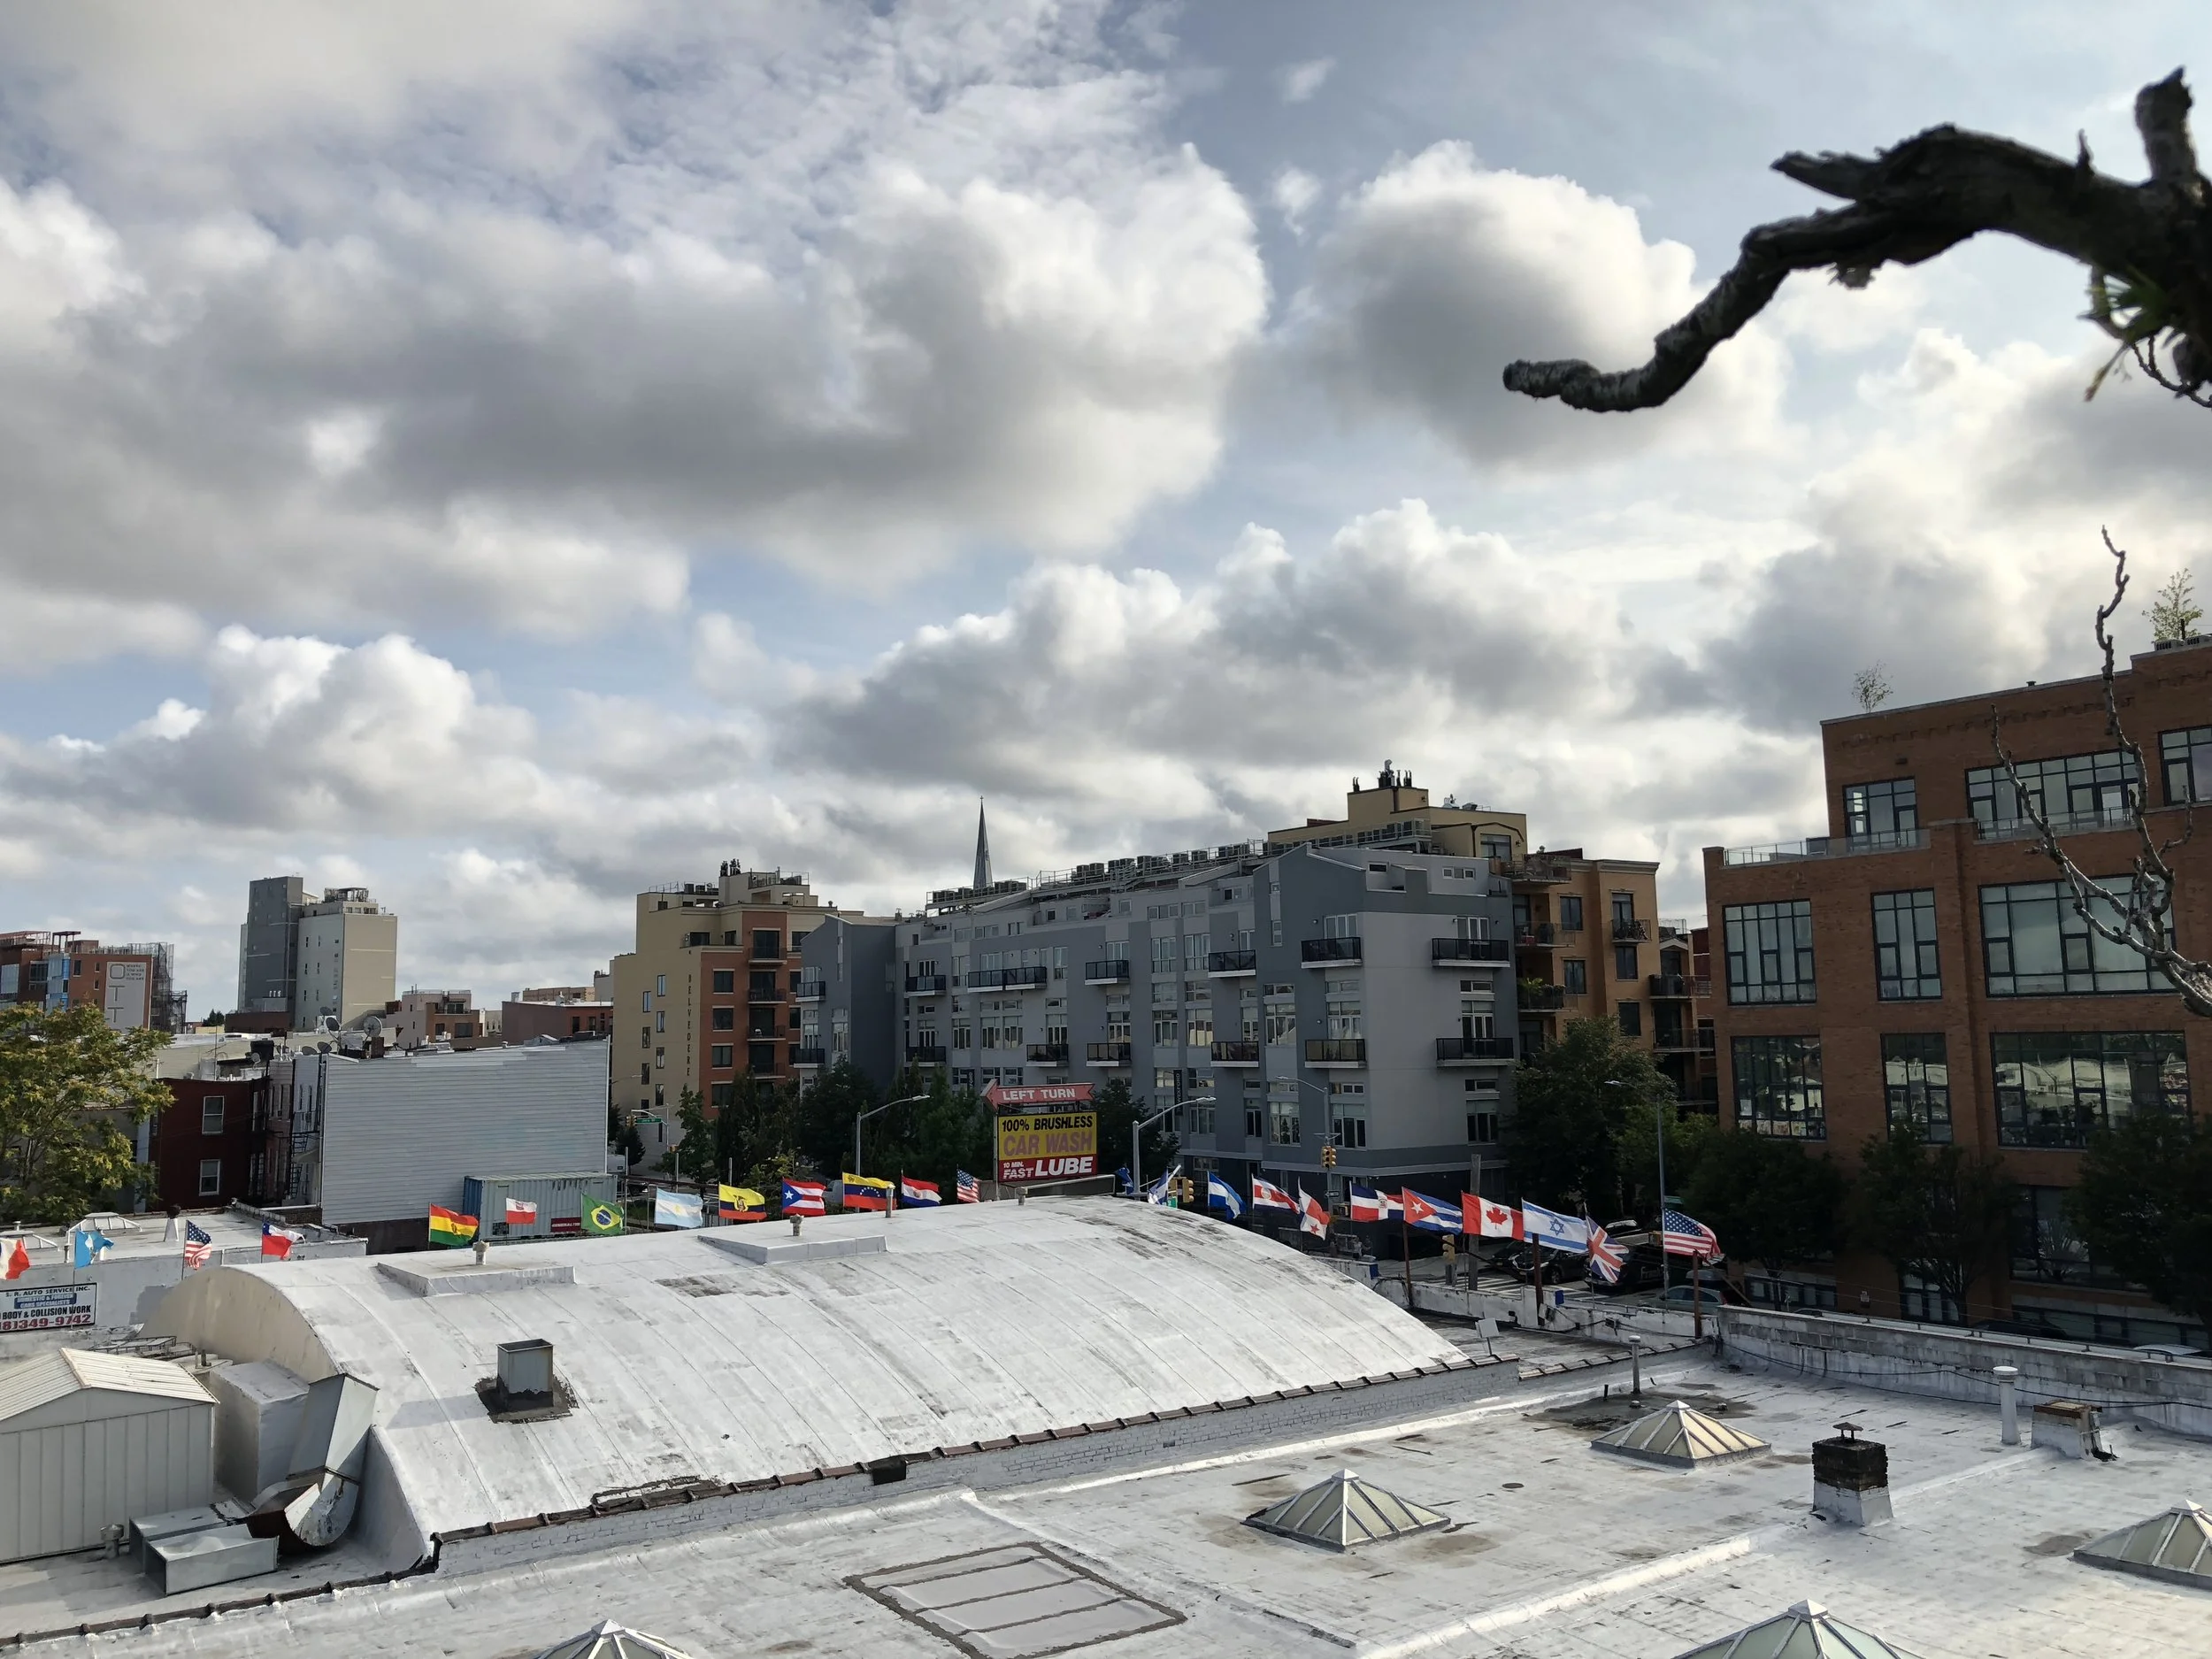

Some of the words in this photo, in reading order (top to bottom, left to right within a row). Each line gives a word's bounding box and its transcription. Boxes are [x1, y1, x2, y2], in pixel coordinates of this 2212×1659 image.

[107, 964, 126, 1033] OTT
[1002, 1089, 1034, 1101] LEFT
[1041, 1088, 1076, 1098] TURN
[1002, 1118, 1029, 1132] 100%
[1033, 1116, 1093, 1131] BRUSHLESS
[1003, 1134, 1040, 1156] CAR
[1046, 1132, 1093, 1153] WASH
[1002, 1168, 1033, 1179] FAST
[1034, 1156, 1094, 1177] LUBE
[3, 1310, 22, 1320] BODY
[23, 1310, 29, 1318] &
[30, 1307, 67, 1317] COLLISION
[69, 1305, 91, 1314] WORK
[0, 1314, 91, 1330] 8)349-9742
